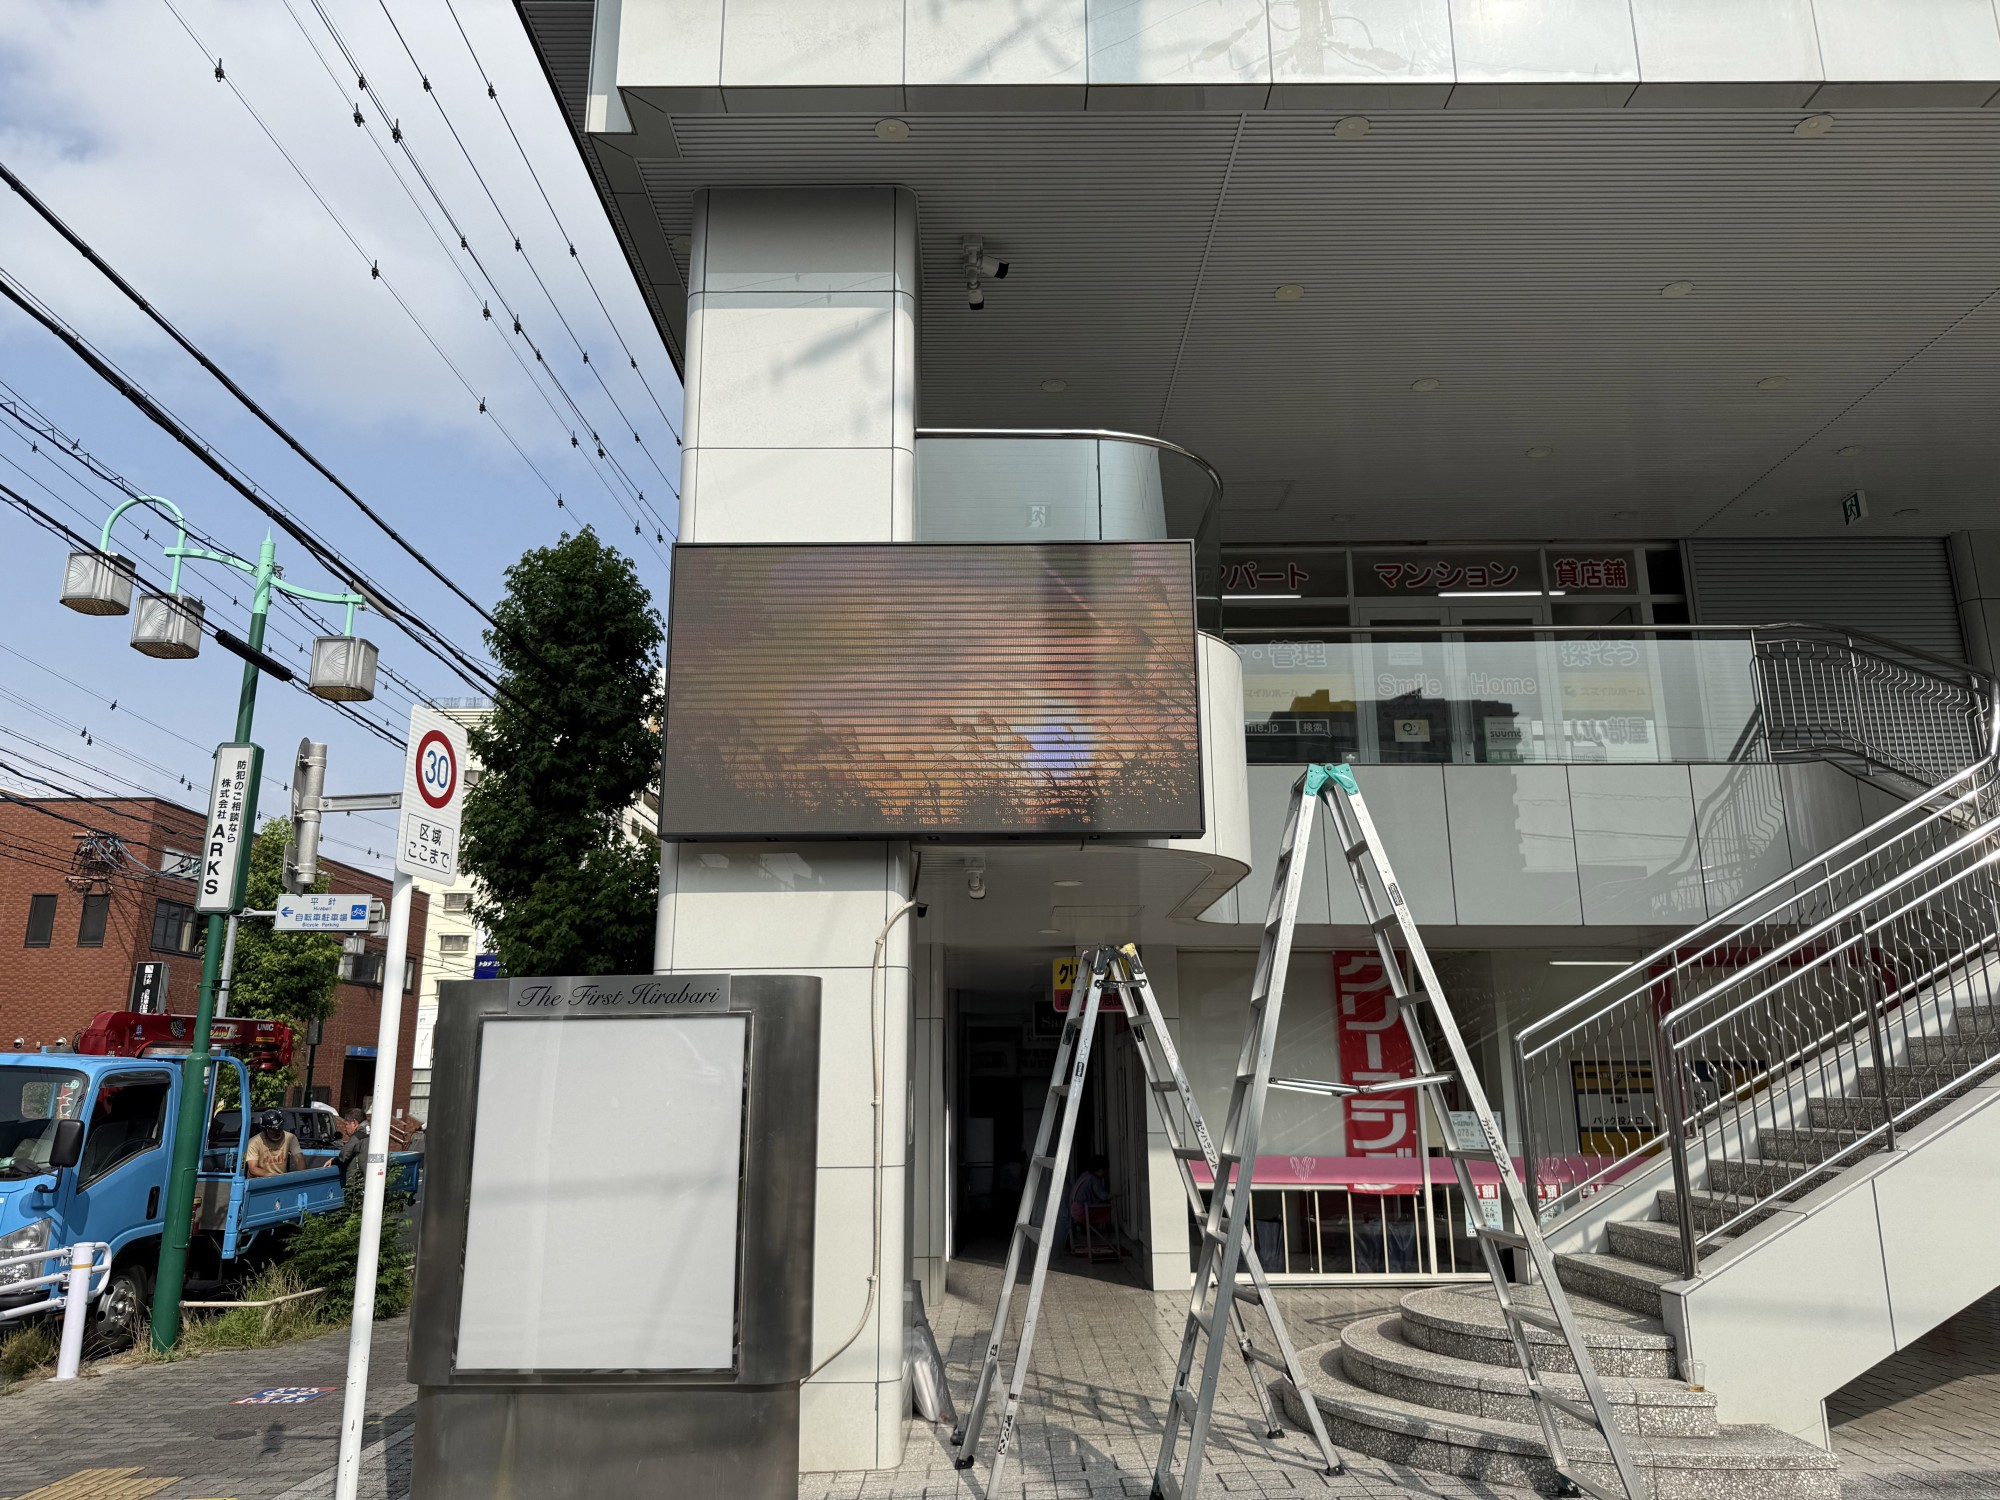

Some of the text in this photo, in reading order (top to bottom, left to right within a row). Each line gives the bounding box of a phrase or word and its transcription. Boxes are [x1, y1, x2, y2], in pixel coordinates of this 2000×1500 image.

[1374, 562, 1518, 588] マンション
[1553, 558, 1628, 588] 貸店舗
[1561, 640, 1639, 667] 探そう
[1377, 672, 1537, 697] Smile Home
[1570, 716, 1650, 745] いい部屋
[425, 750, 449, 789] 30
[227, 760, 247, 843] 防犯のご相談なら
[204, 778, 232, 895] 株式会社 ARKS
[419, 823, 442, 846] 区域
[408, 841, 450, 868] ここまで
[517, 982, 721, 1007] The First Hirabari
[257, 1023, 274, 1031] UNIC
